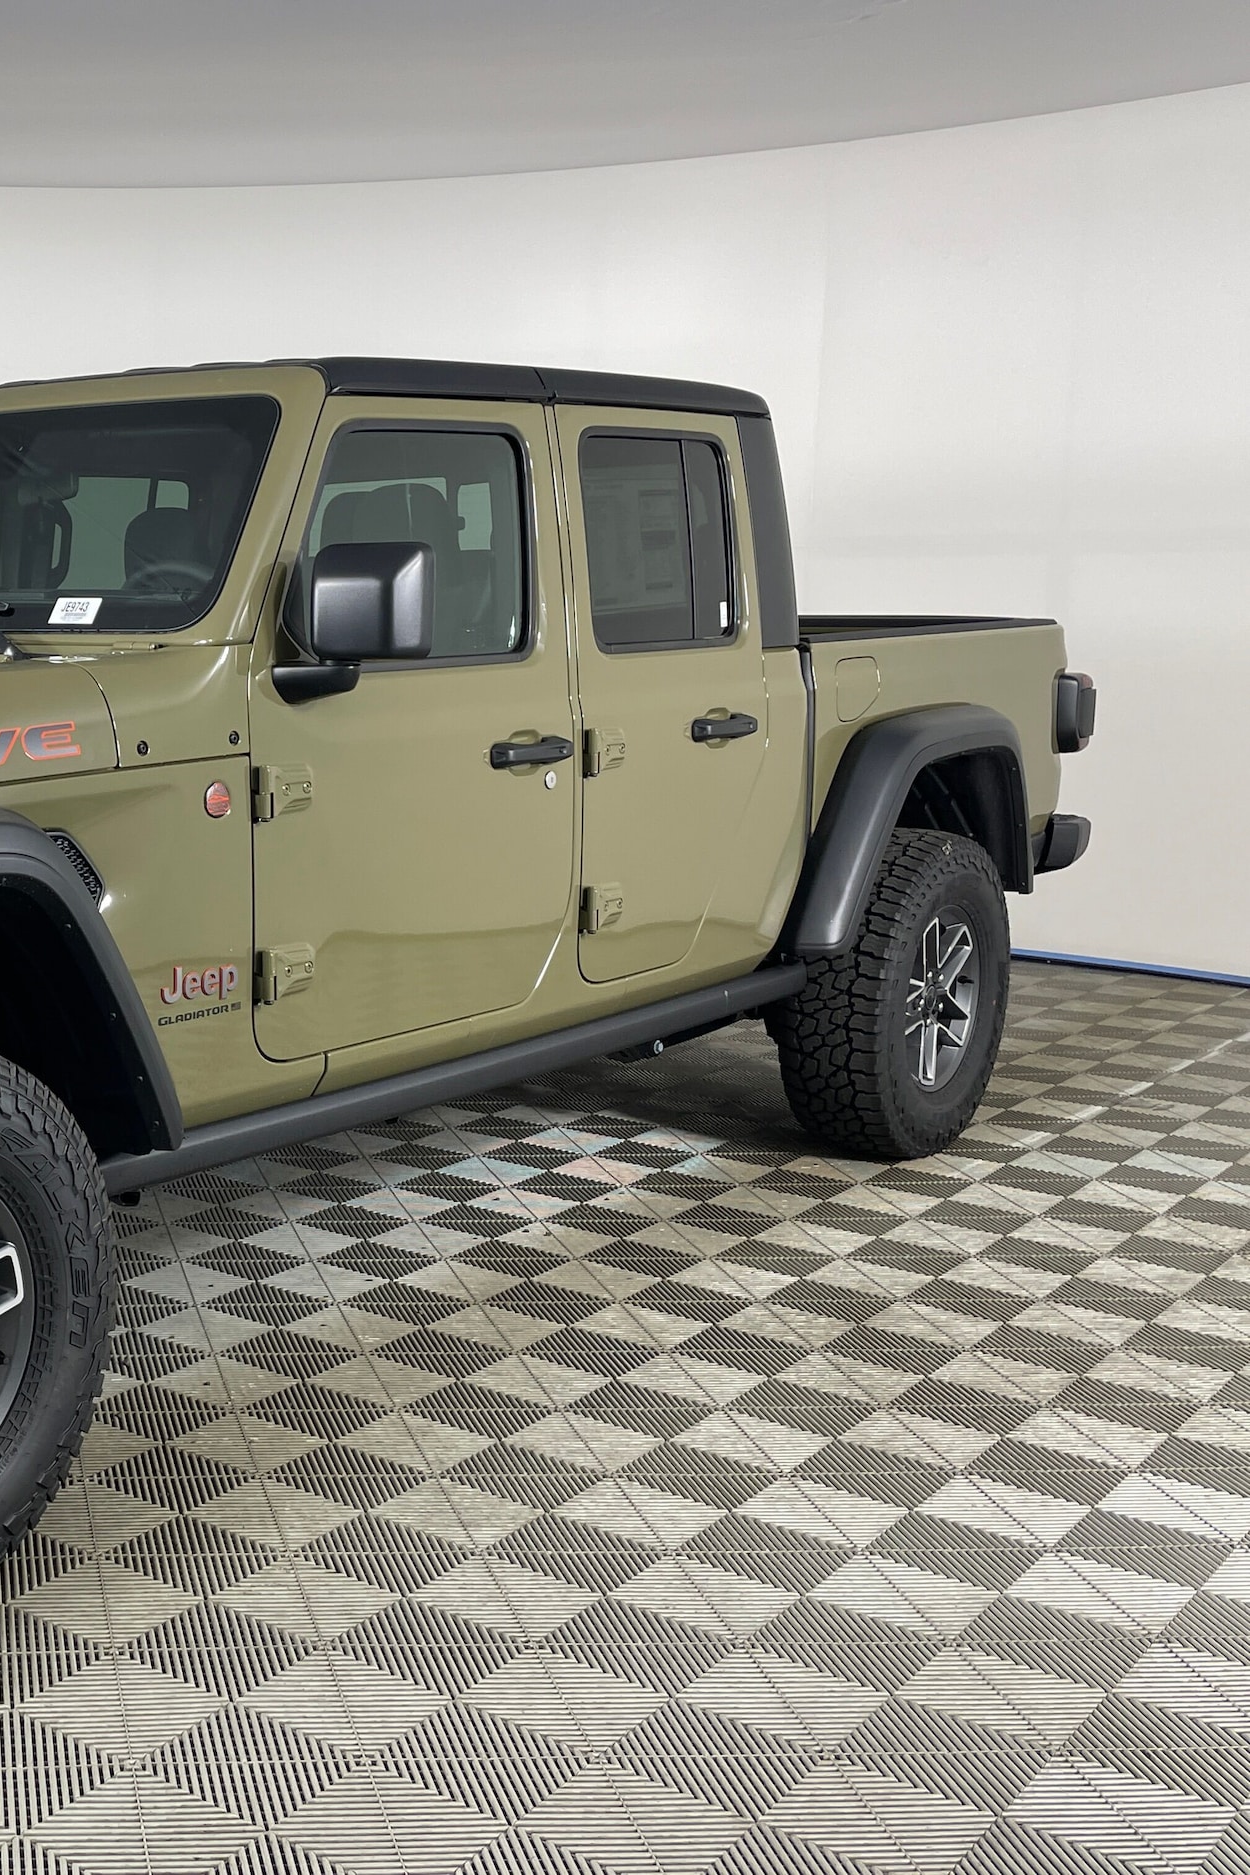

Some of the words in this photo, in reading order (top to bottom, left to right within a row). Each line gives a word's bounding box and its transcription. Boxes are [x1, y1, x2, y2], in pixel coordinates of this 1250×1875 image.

[60, 601, 90, 613] JE9743
[160, 963, 239, 1005] Jeep
[157, 1004, 230, 1027] GLADIATOR
